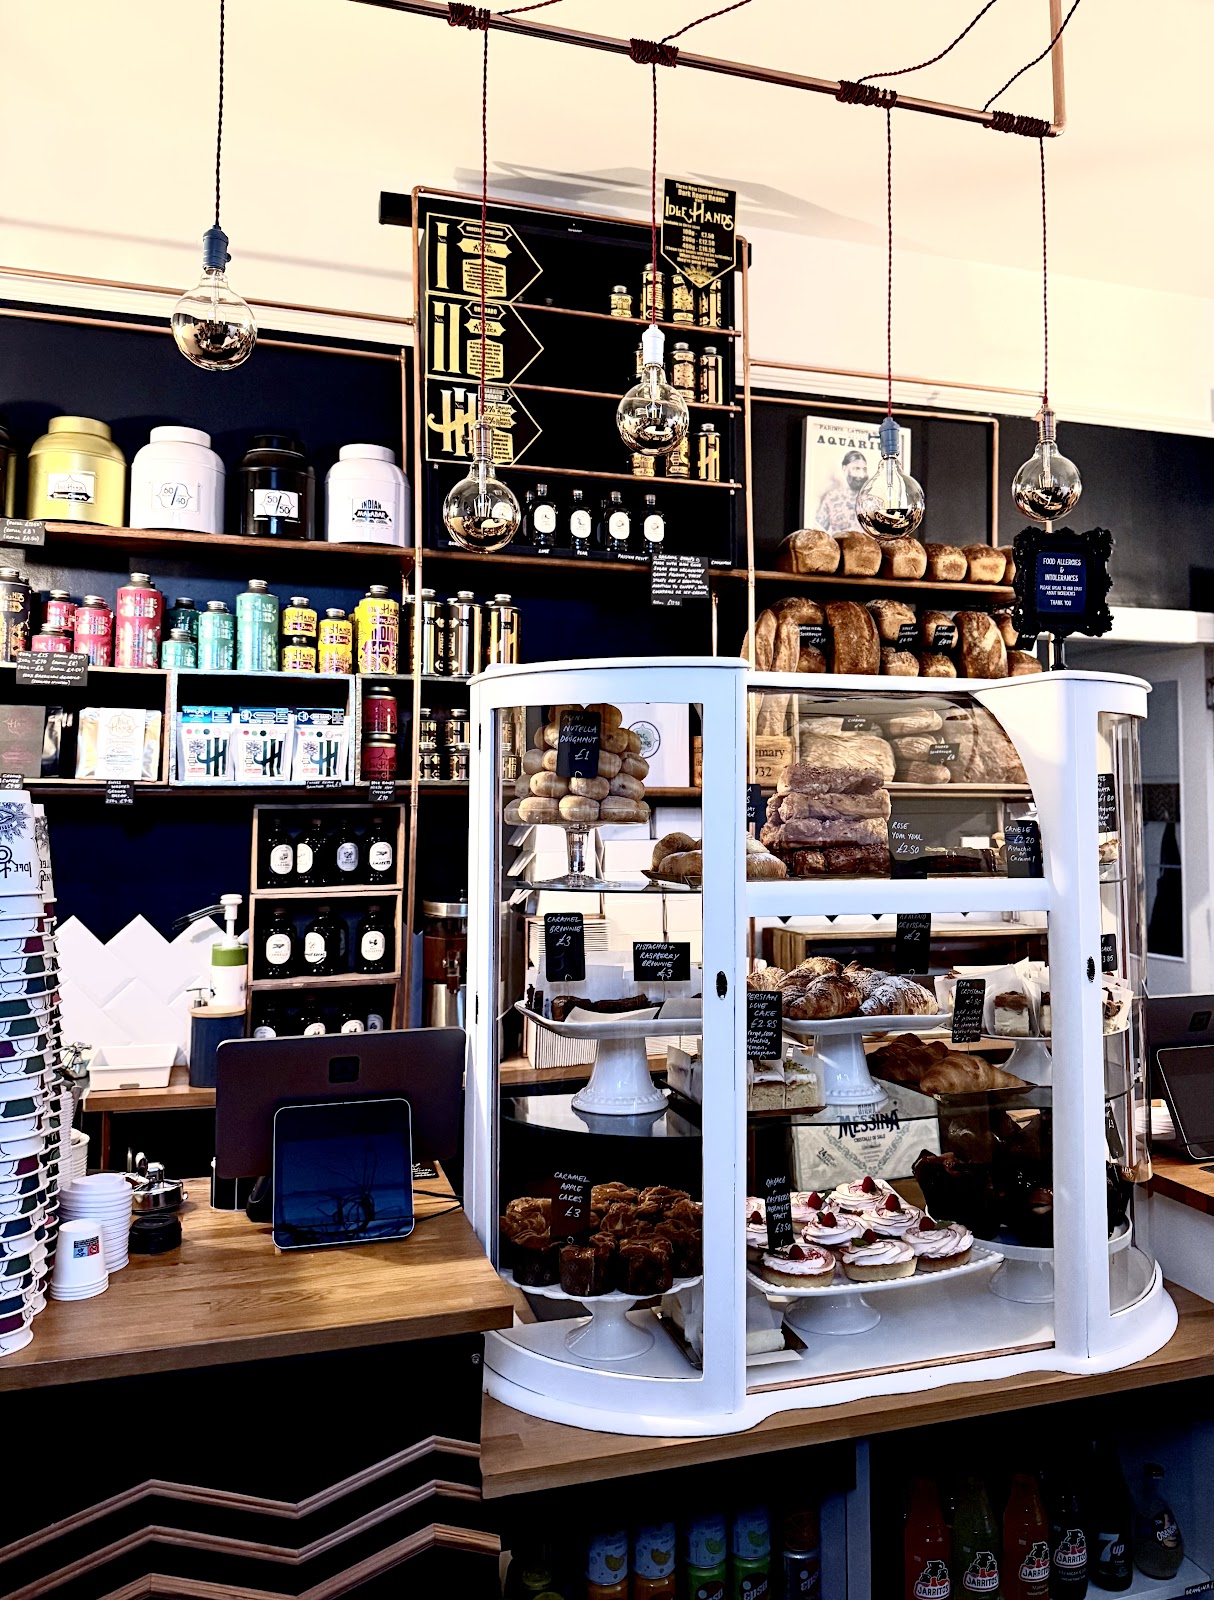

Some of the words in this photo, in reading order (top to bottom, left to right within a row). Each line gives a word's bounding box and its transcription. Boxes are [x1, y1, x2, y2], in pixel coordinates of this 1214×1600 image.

[692, 192, 707, 200] Roast
[708, 195, 725, 203] Beans
[665, 196, 692, 223] IDLE
[689, 202, 733, 230] HANDS
[362, 500, 381, 509] INDIAN
[563, 725, 597, 733] NUTELLA
[560, 735, 598, 744] DOUGHNUT
[575, 749, 589, 760] £1
[556, 934, 571, 946] £3
[904, 930, 920, 941] £2
[657, 969, 673, 978] £3
[837, 1109, 901, 1139] MESSINA
[554, 1171, 590, 1182] CARAMEL
[561, 1184, 583, 1193] APPLE
[559, 1193, 582, 1203] CAKES
[565, 1206, 581, 1218] £3
[967, 1577, 998, 1586] JARRITOS
[918, 1585, 949, 1596] JARRITOS
